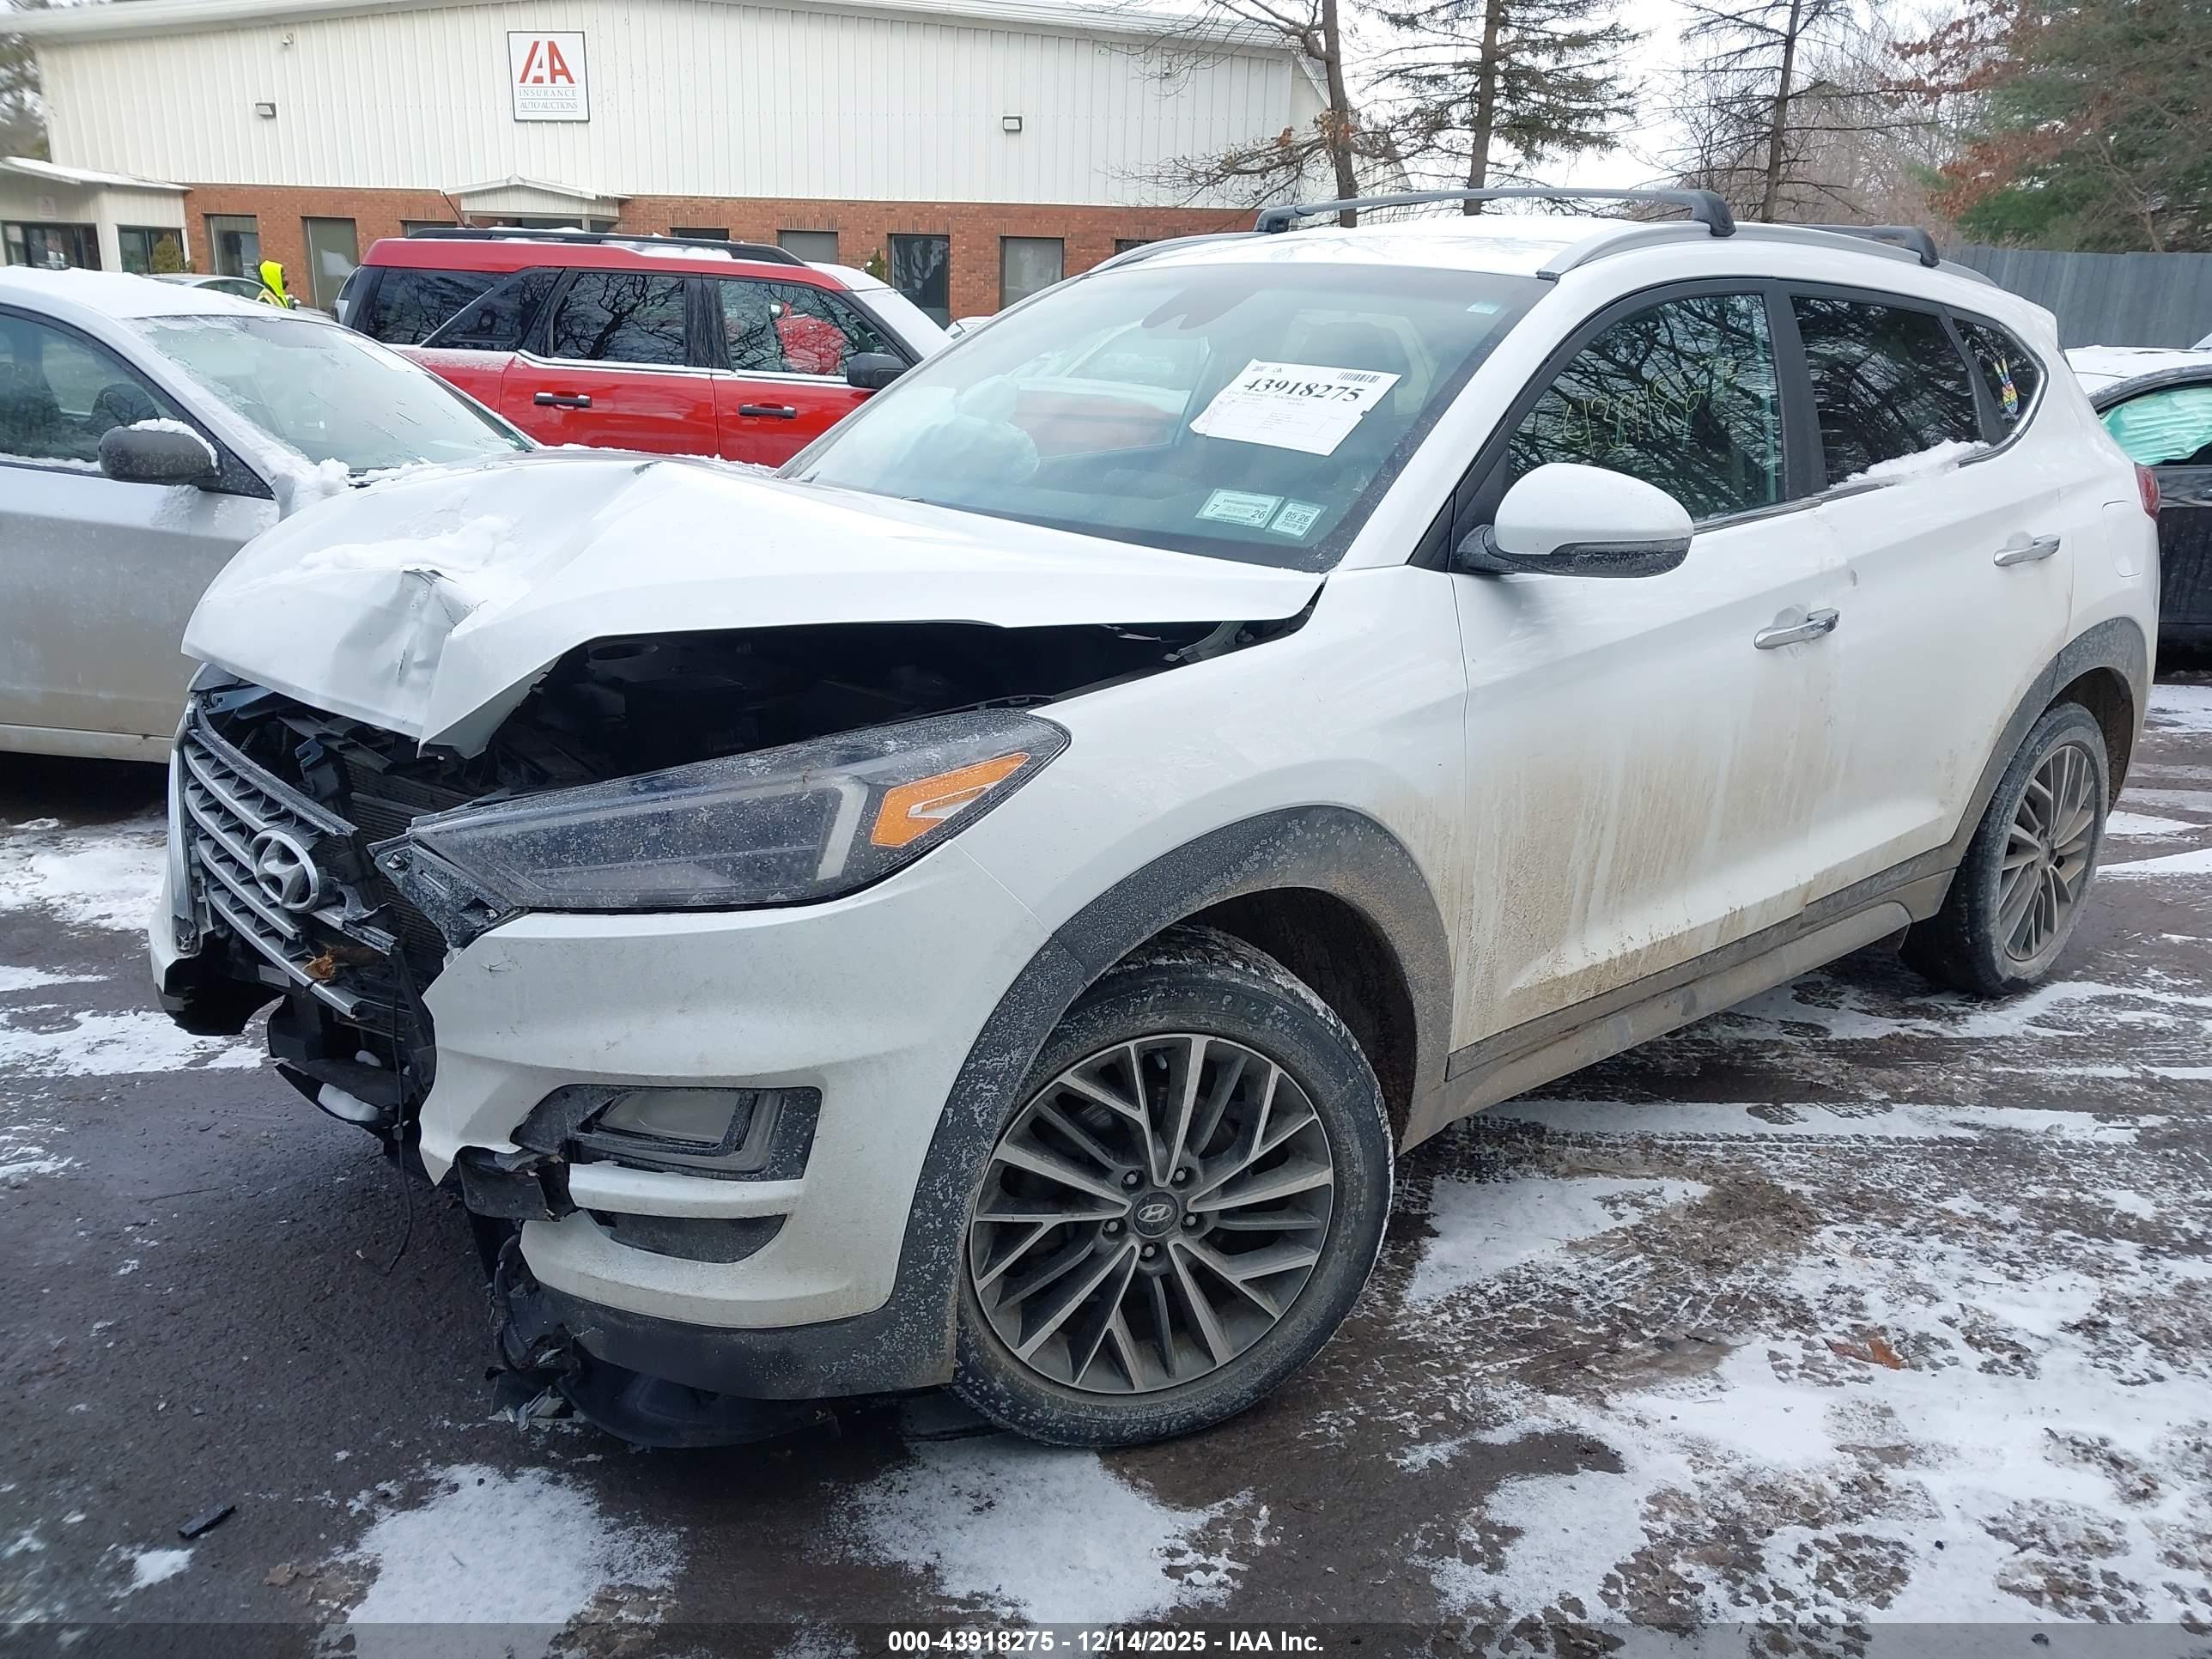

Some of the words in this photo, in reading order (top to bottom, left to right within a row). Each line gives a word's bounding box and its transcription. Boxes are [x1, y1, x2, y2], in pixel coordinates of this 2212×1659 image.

[519, 88, 577, 97] INSURANCE
[541, 101, 578, 110] AUCTIONS
[1243, 378, 1365, 402] 43918275
[1210, 503, 1220, 512] 7
[1250, 509, 1267, 520] 26
